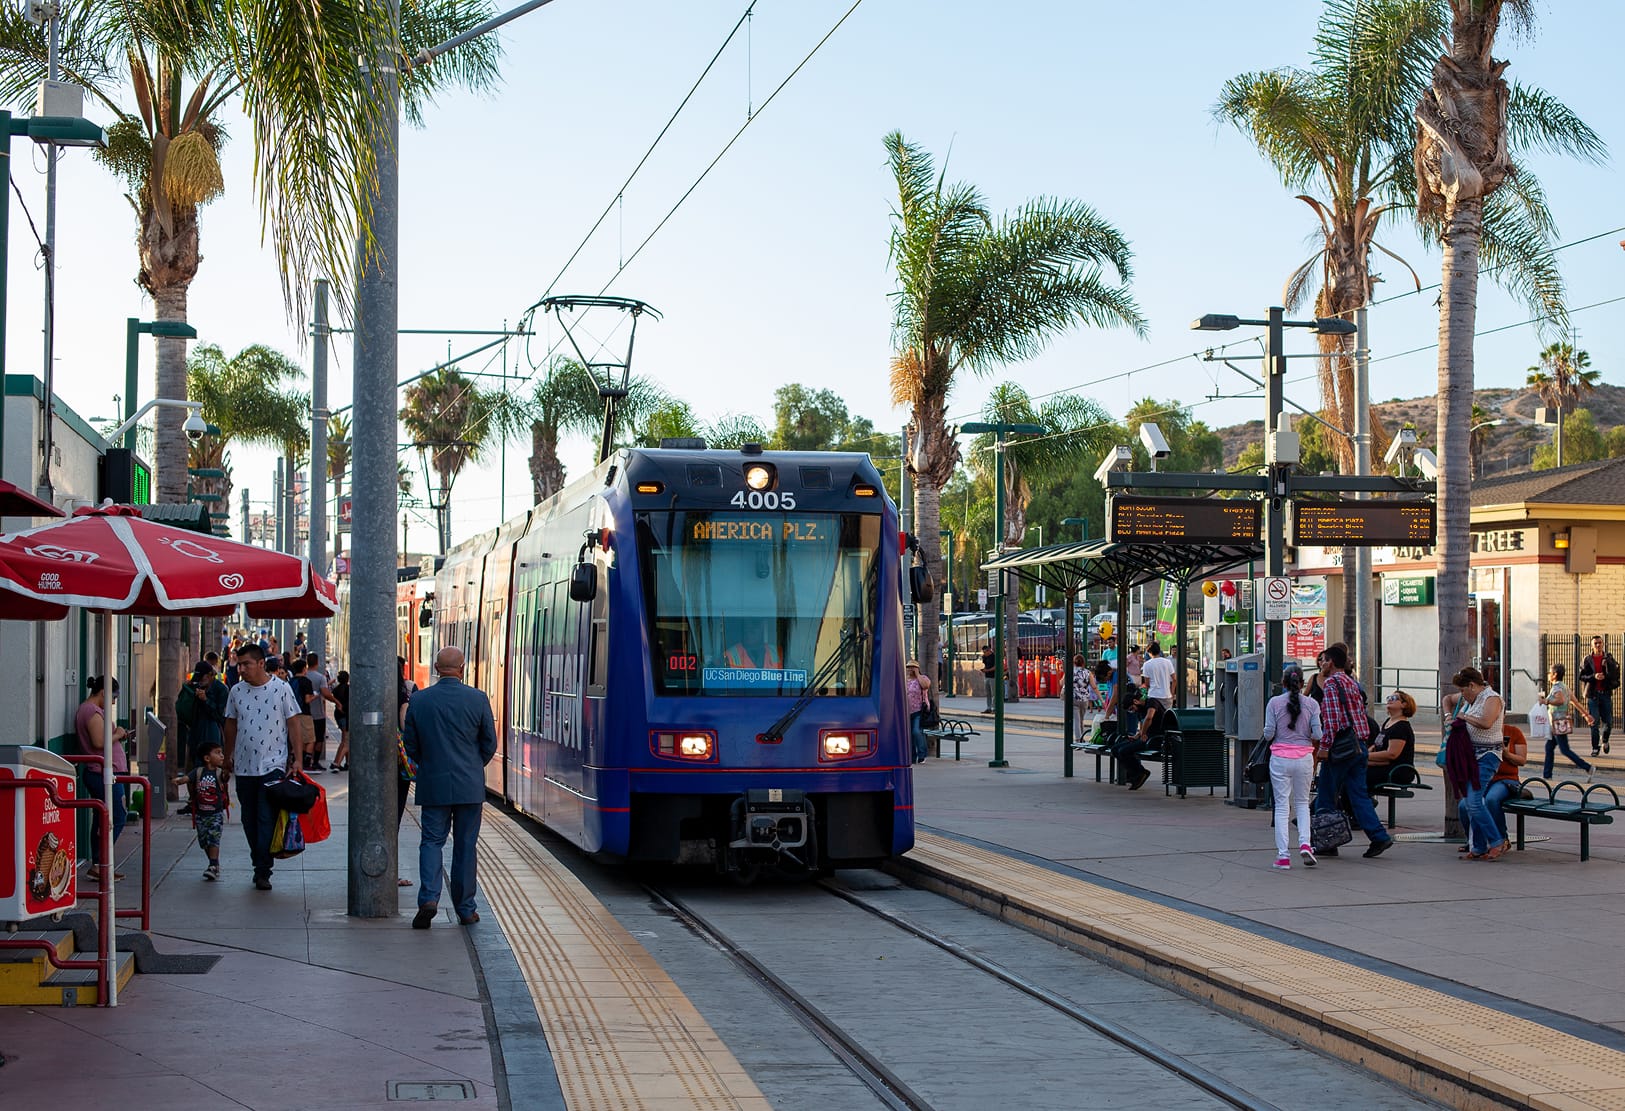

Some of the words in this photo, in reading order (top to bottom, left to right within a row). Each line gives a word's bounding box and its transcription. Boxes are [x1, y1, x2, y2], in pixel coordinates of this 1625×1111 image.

[730, 490, 797, 510] 4005
[693, 521, 773, 539] AMERICA
[783, 522, 825, 540] PLZ.
[40, 572, 60, 581] GOOD
[669, 655, 697, 670] 002
[705, 670, 718, 681] UC
[718, 670, 735, 681] San
[736, 670, 760, 683] Diego
[761, 671, 782, 681] Blue
[784, 671, 804, 682] Line
